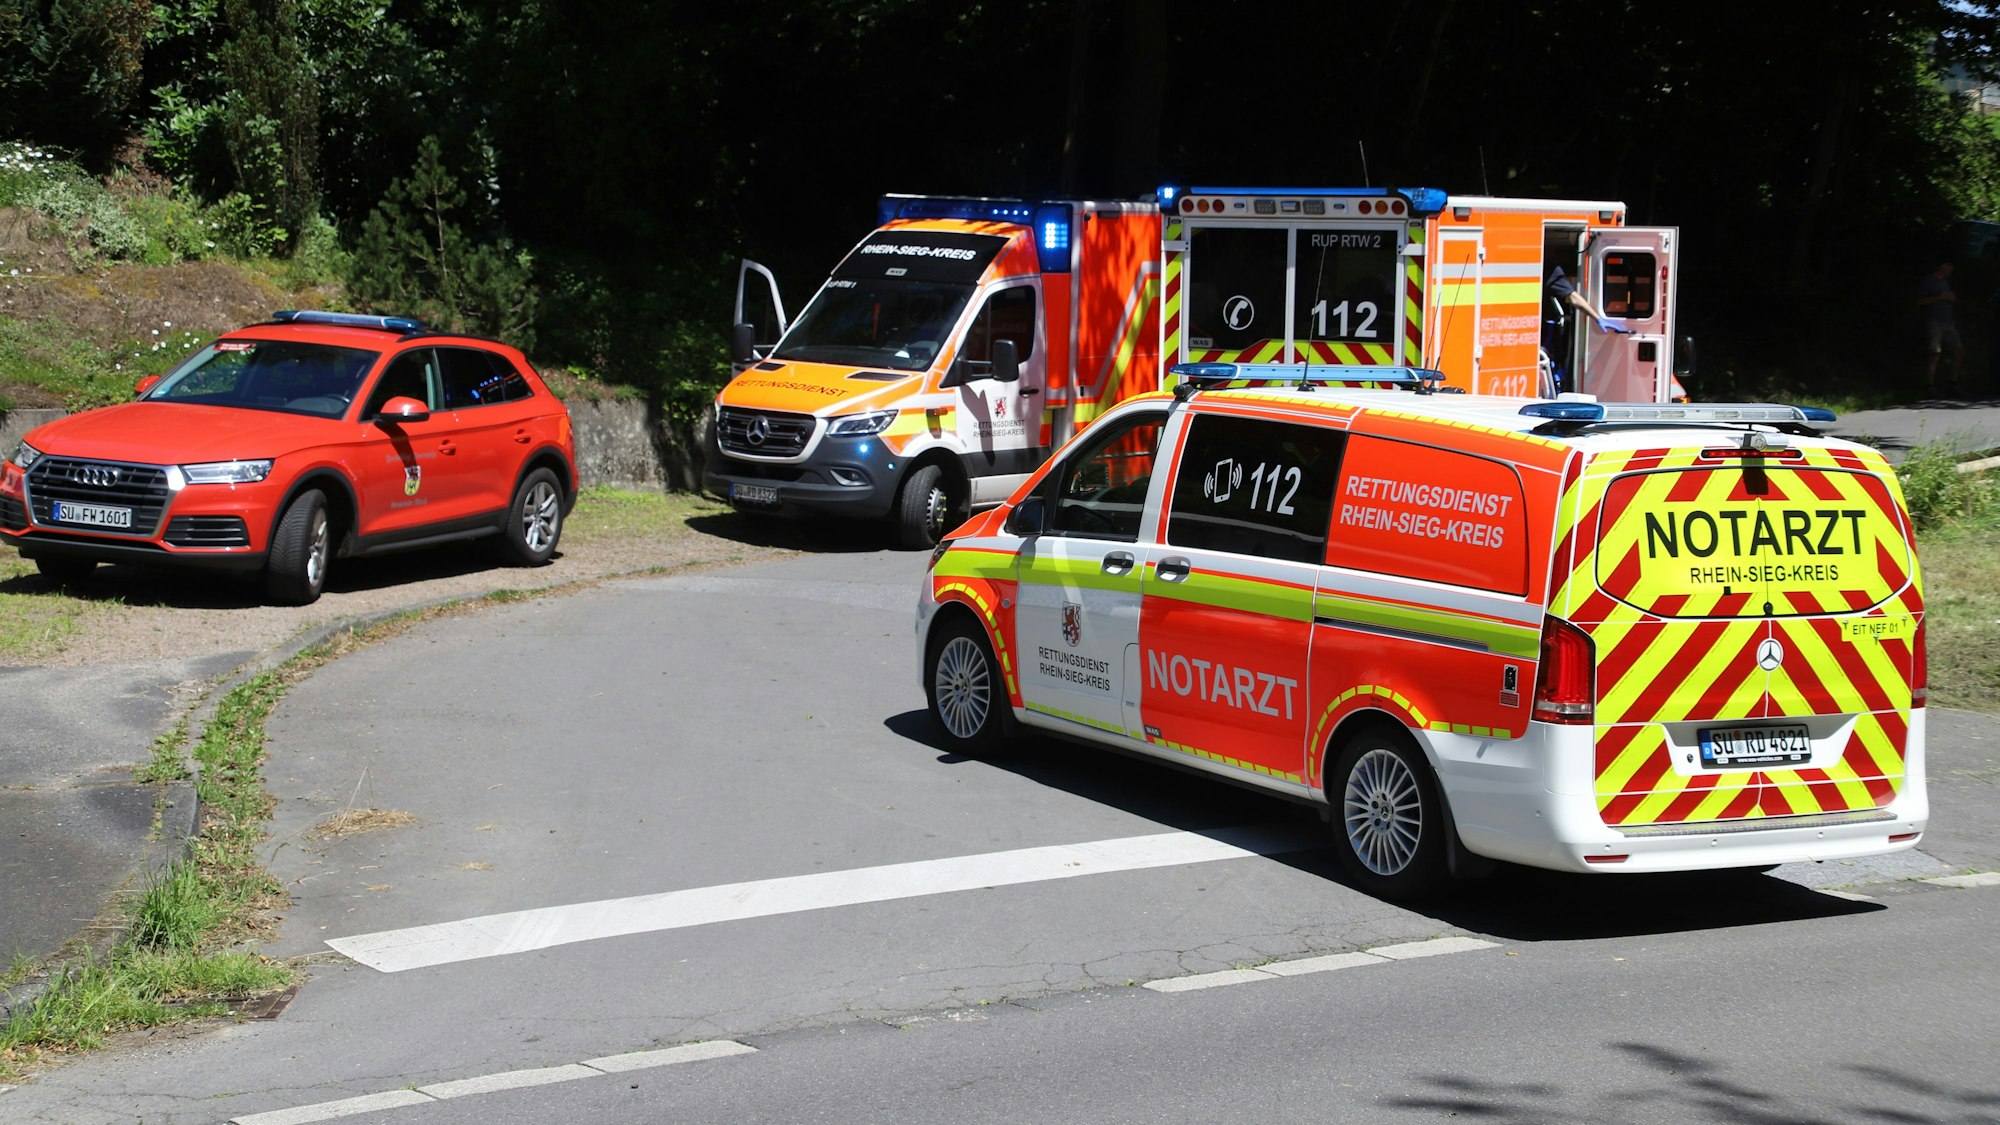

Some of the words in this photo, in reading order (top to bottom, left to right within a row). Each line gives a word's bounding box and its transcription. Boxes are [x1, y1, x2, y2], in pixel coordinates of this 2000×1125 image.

[1311, 234, 1338, 248] RUP
[1341, 235, 1371, 248] RTW
[1373, 235, 1381, 248] 2
[860, 244, 976, 261] RHEIN-SIEG-KREIS
[1311, 299, 1378, 338] 112
[1480, 315, 1539, 331] RETTUNGSDIENST
[1480, 332, 1538, 347] RHEIN-SIEG-KREIS
[734, 380, 848, 397] RETTUNGSDIENST
[1503, 374, 1528, 398] 112
[972, 428, 1025, 439] RHEIN-SIEG-KREIS
[973, 419, 1025, 429] RETTUNGSDIENST
[1250, 462, 1301, 516] 112
[1346, 475, 1513, 518] RETTUNGSDIENST
[60, 506, 74, 520] SU
[83, 508, 97, 523] FW
[99, 510, 127, 525] 1601
[1339, 504, 1504, 549] RHEIN-SIEG-KREIS
[1645, 510, 1866, 558] NOTARZT
[1690, 565, 1839, 584] RHEIN-SIEG-KREIS
[1853, 624, 1867, 635] EIT
[1869, 623, 1887, 634] NEF
[1890, 622, 1898, 633] 01
[1038, 646, 1110, 675] RETTUNGSDIENST
[1039, 662, 1110, 691] RHEIN-SIEG-KREIS
[1148, 649, 1298, 720] NOTARZT
[1146, 726, 1160, 736] WAS
[1713, 732, 1734, 755] SU
[1744, 730, 1766, 754] RD
[1770, 729, 1807, 753] 4821
